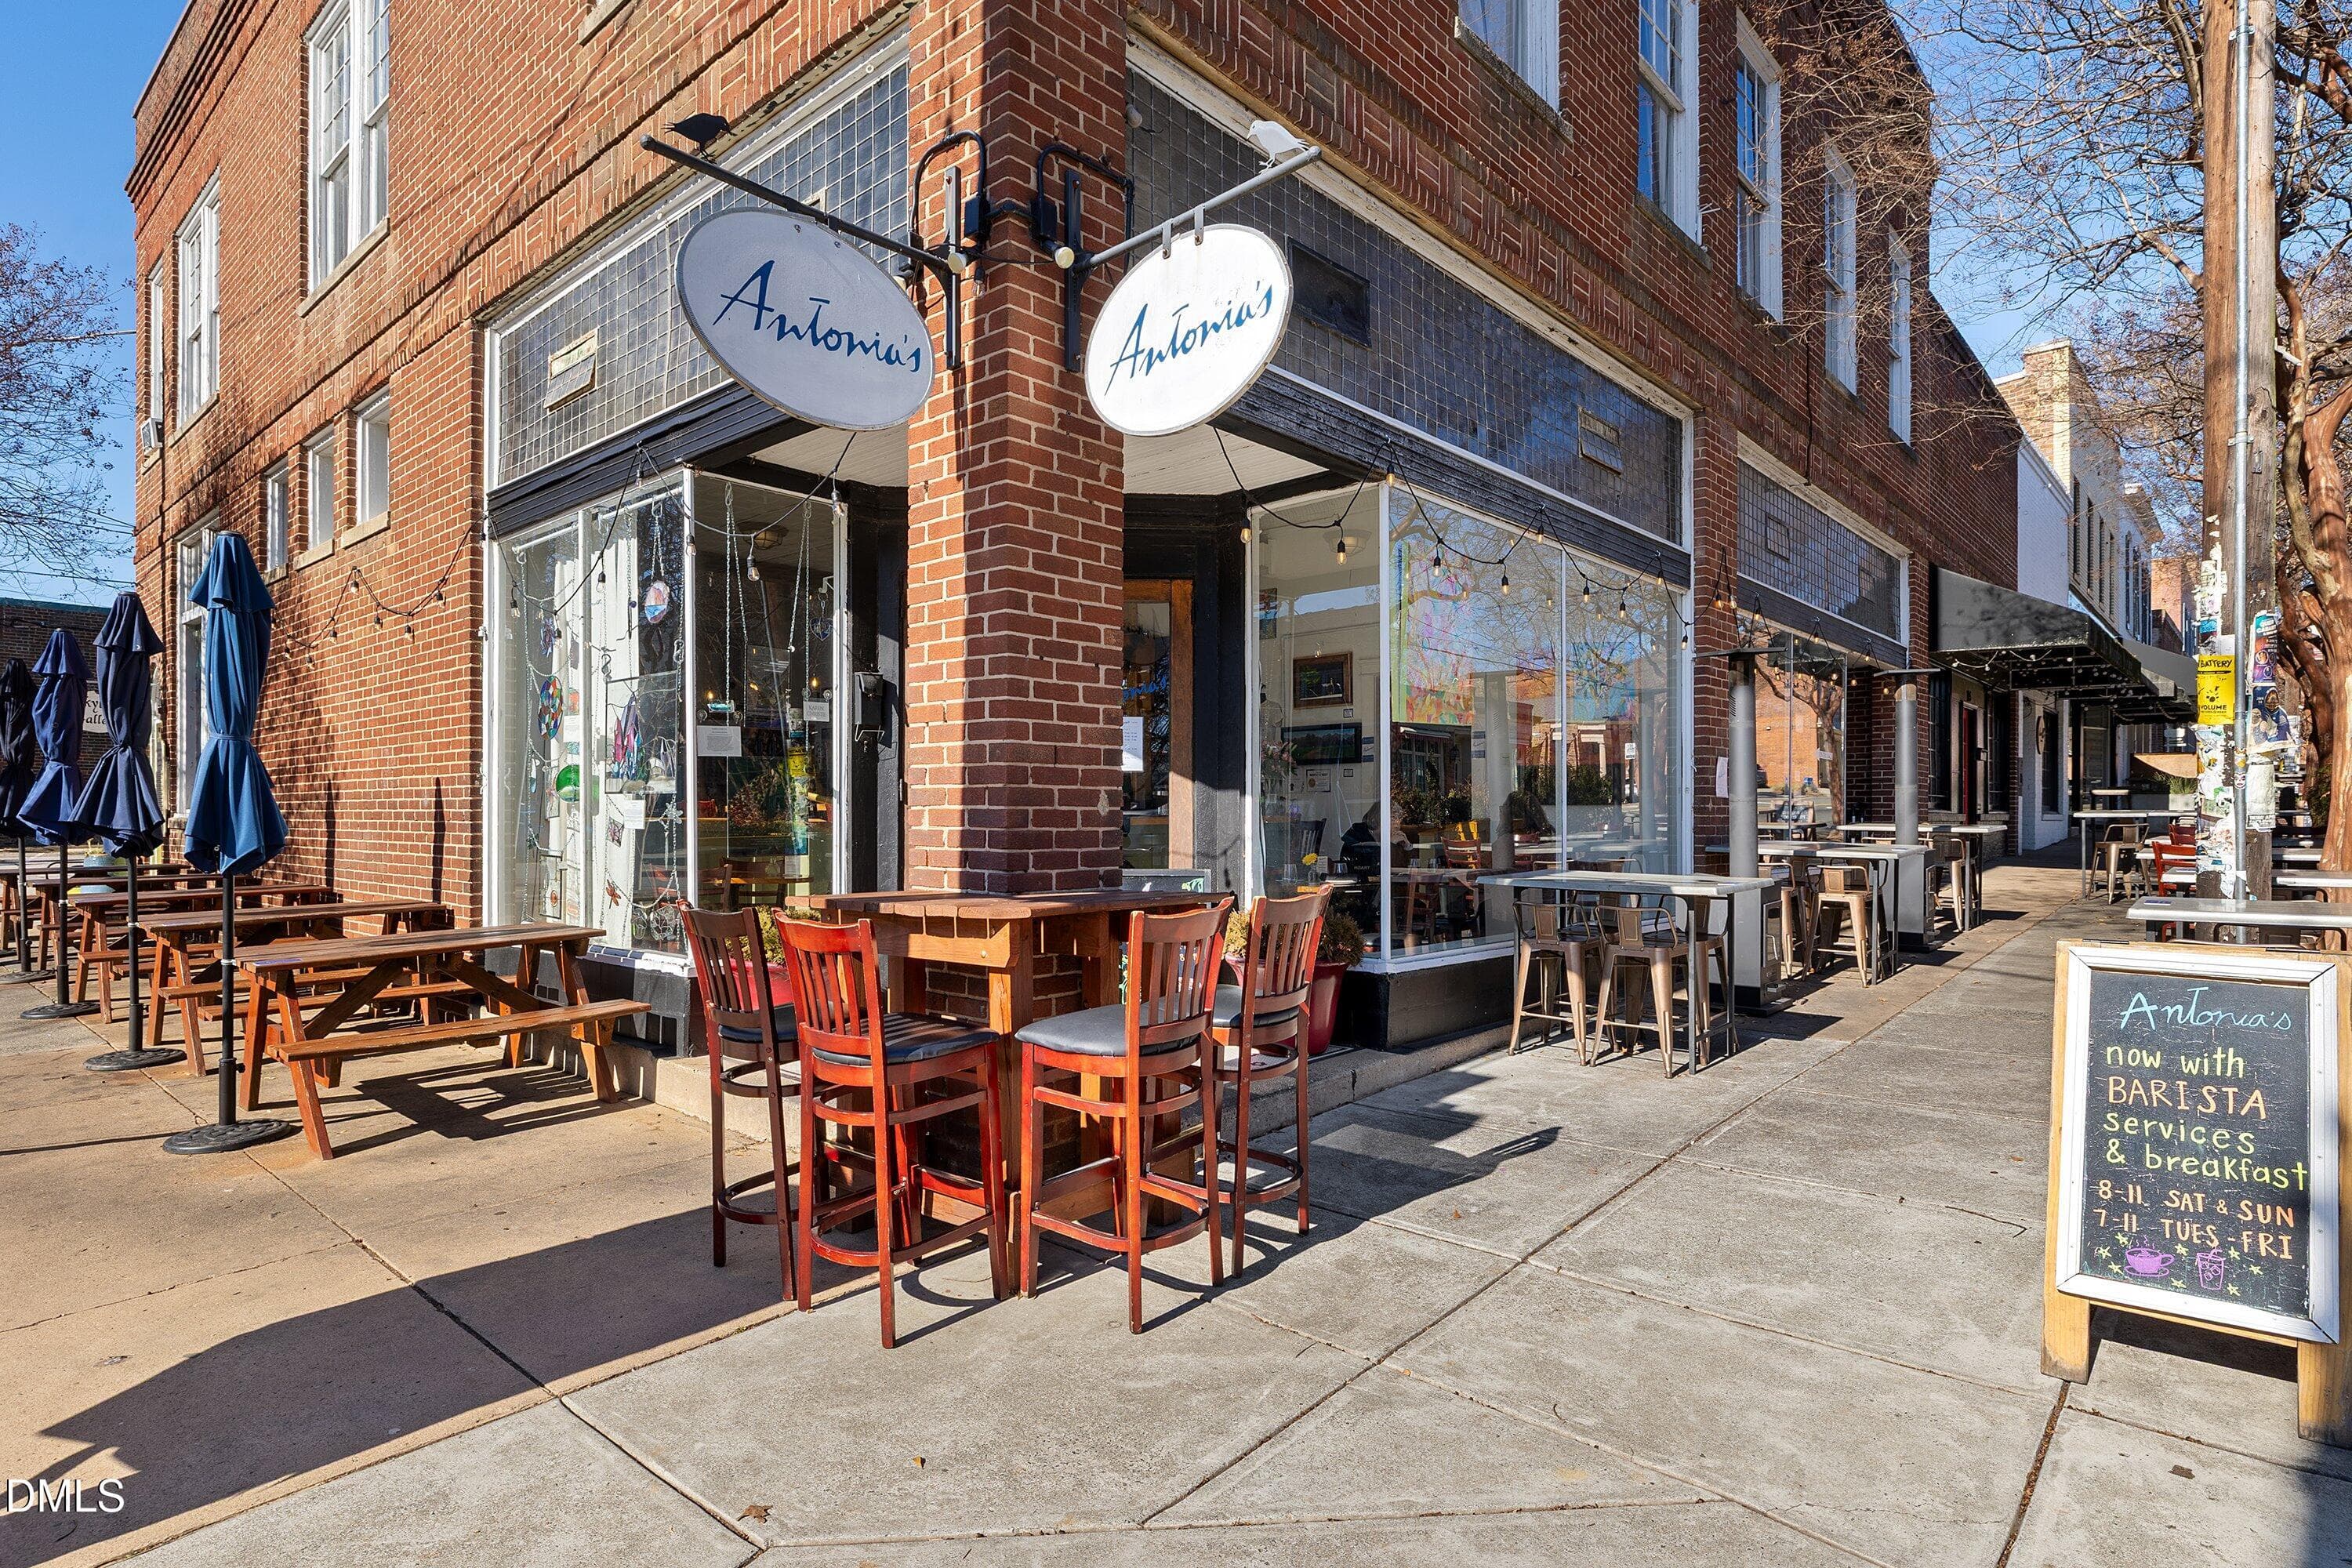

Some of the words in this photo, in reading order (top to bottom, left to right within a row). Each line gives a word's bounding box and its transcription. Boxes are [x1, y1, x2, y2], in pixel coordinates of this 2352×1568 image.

[712, 260, 920, 372] Antonia's
[1104, 280, 1272, 397] Antonia's
[2107, 1045, 2161, 1069] now
[2181, 1047, 2245, 1078] with
[2108, 1076, 2267, 1120] BARISTA
[2103, 1112, 2255, 1155] services
[2106, 1138, 2125, 1164] &
[2145, 1143, 2308, 1191] breakfast
[2098, 1179, 2143, 1205] 8-11
[2163, 1189, 2205, 1213] SAT
[2216, 1199, 2229, 1215] &
[2237, 1200, 2295, 1229] SUN
[2092, 1208, 2137, 1233] 7-11
[2160, 1218, 2220, 1248] TUES
[2241, 1231, 2293, 1260] FRI
